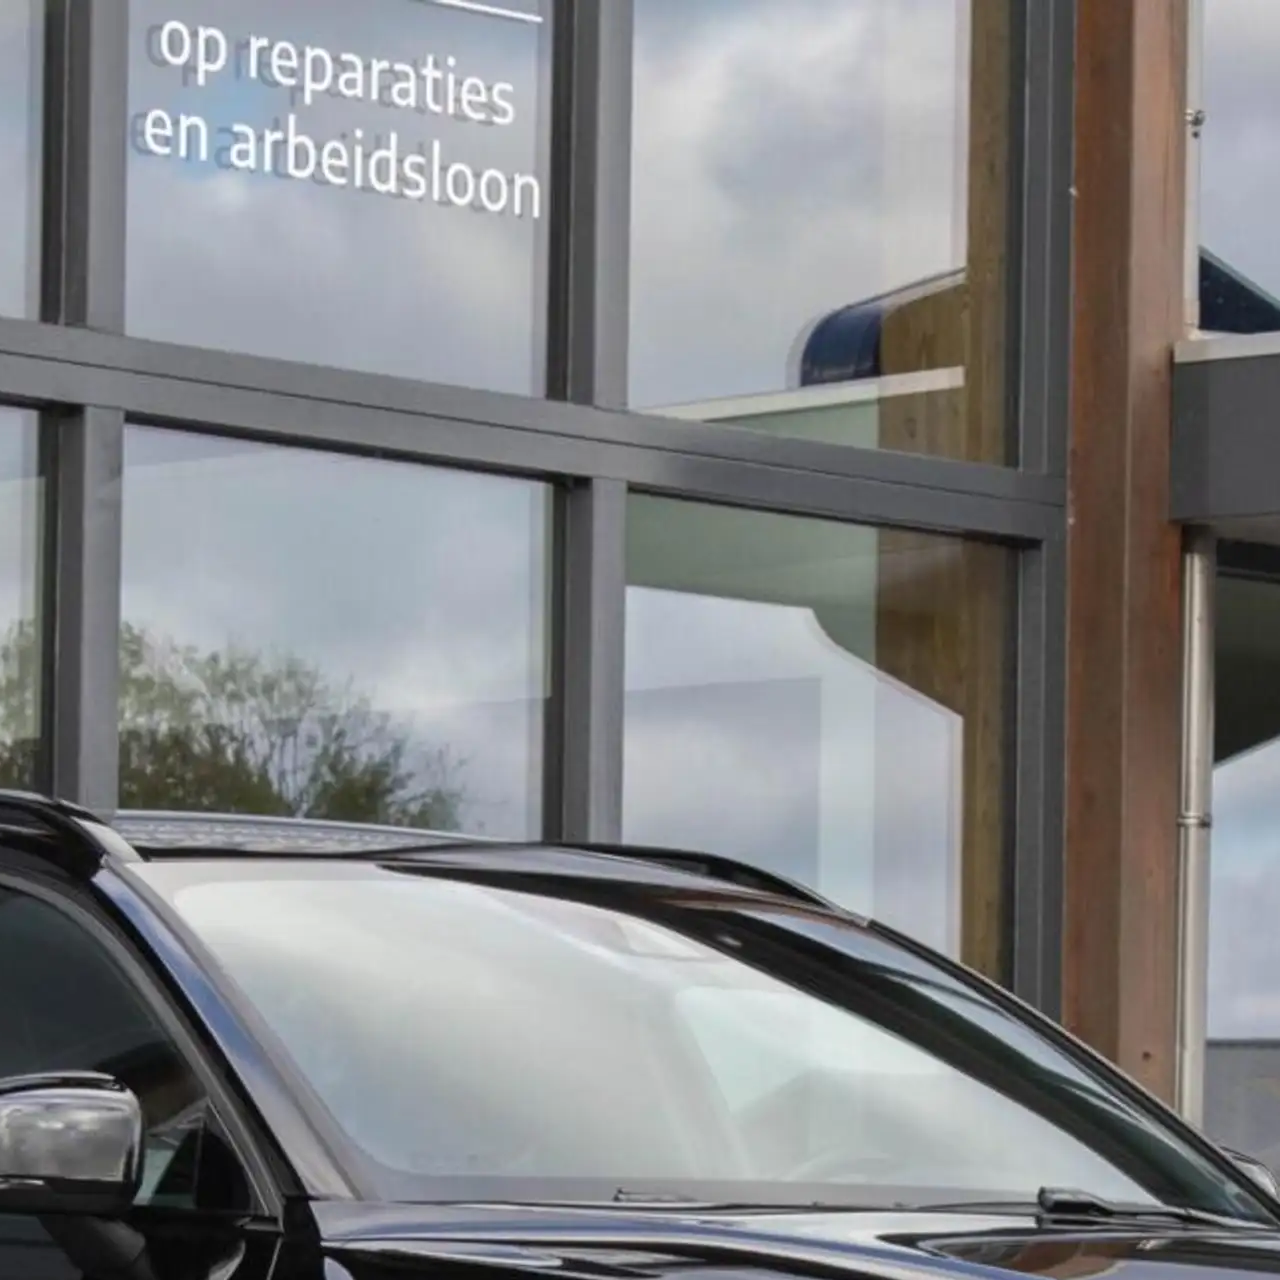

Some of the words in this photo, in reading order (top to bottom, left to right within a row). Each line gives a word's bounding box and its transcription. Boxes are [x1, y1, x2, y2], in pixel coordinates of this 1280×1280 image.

[159, 19, 227, 86] op
[248, 32, 516, 126] reparaties
[143, 106, 208, 162] en
[229, 114, 541, 219] arbeidsloon
